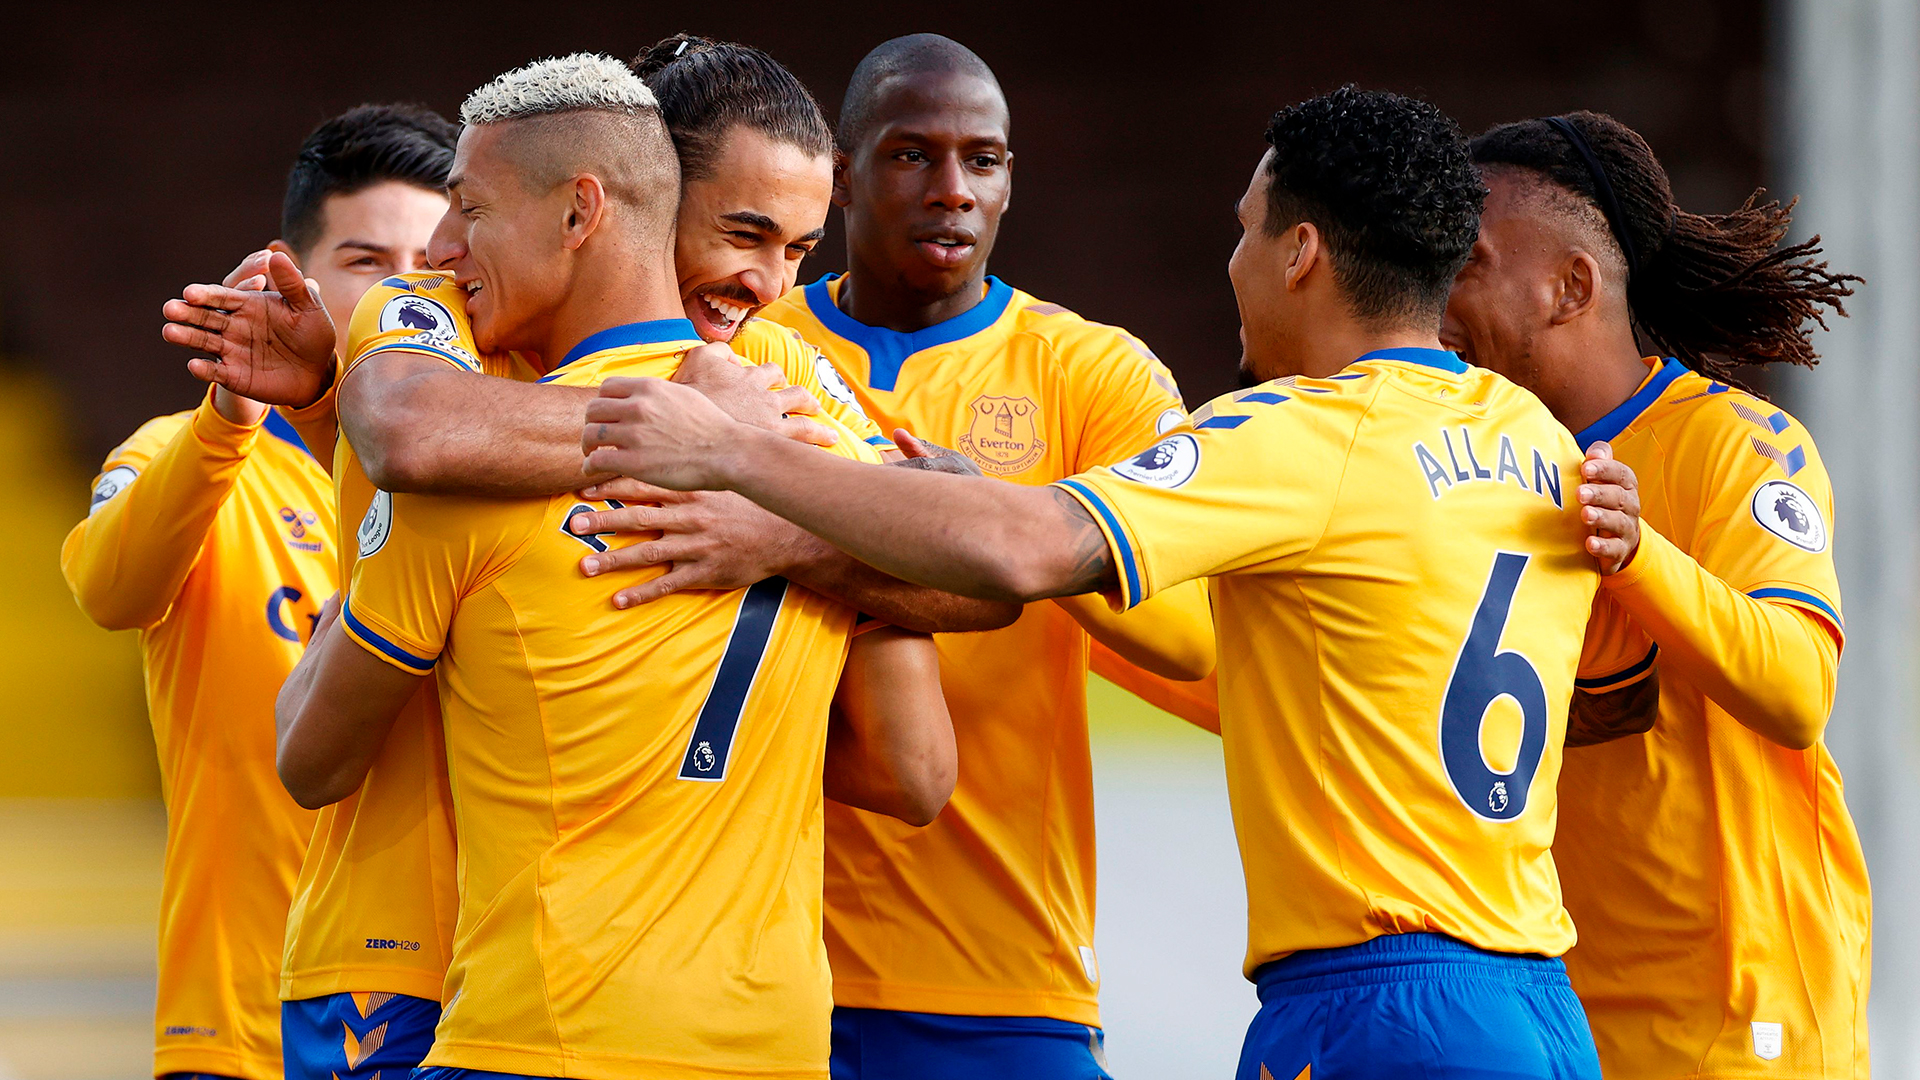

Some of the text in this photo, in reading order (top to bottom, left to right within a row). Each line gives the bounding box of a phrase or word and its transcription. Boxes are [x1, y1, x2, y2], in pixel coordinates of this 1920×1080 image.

[980, 437, 1025, 451] Everton
[1412, 426, 1564, 512] ALLAN
[1154, 469, 1179, 482] League
[1437, 549, 1549, 823] 6
